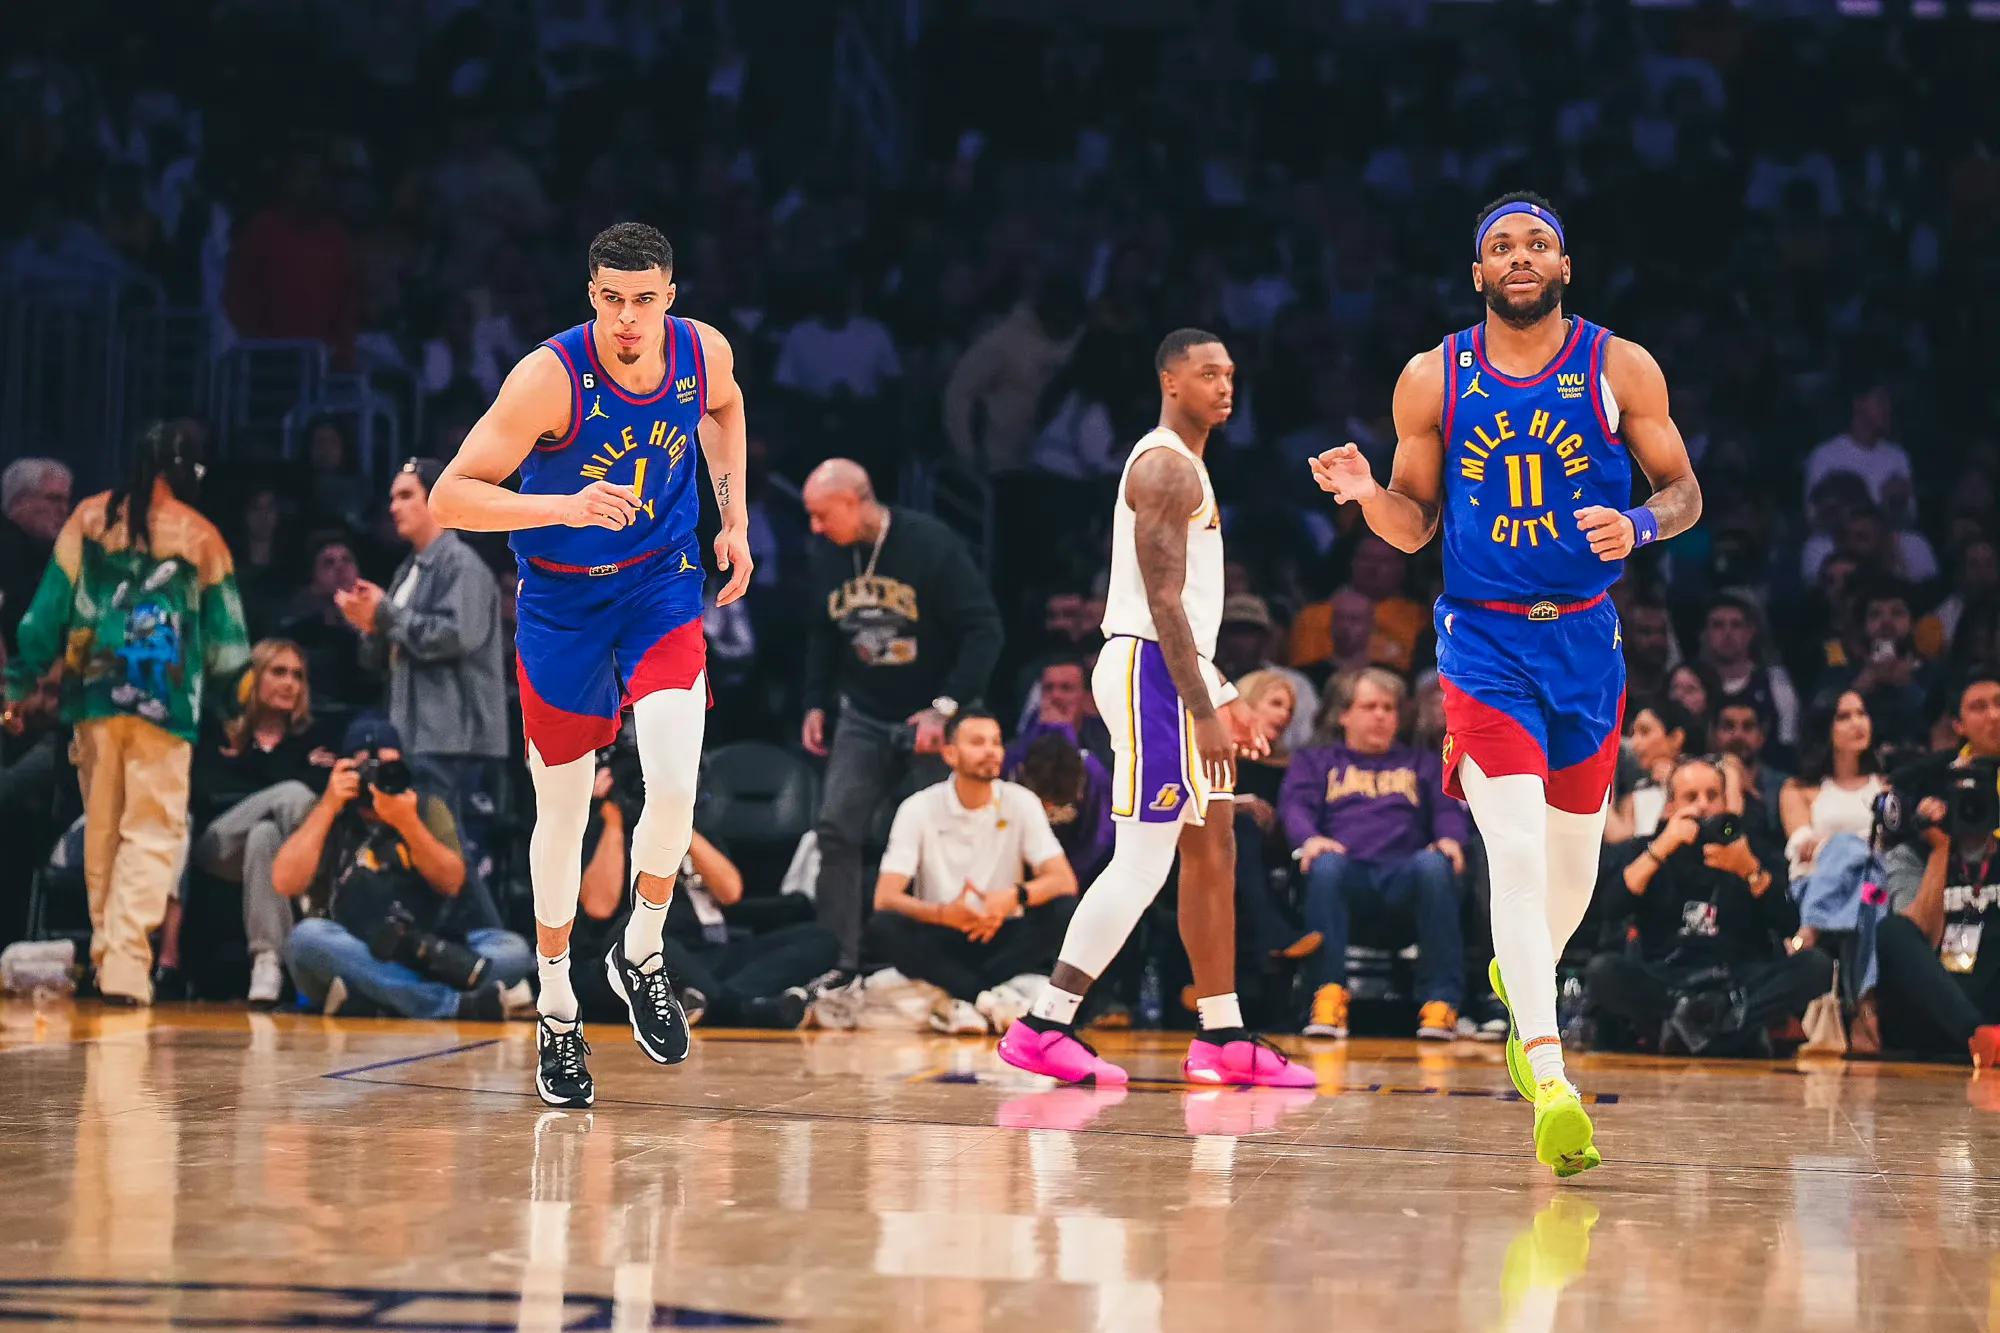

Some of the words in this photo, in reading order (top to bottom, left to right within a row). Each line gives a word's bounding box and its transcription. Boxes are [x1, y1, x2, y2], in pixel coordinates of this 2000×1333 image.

[1459, 351, 1473, 368] 6
[583, 373, 595, 389] 6
[675, 375, 697, 393] WU
[1556, 373, 1585, 386] WU
[676, 389, 697, 400] Western
[1556, 385, 1585, 394] Western
[1561, 392, 1583, 400] Union
[679, 396, 695, 404] Union
[579, 425, 639, 481] MILE
[1460, 410, 1516, 482] MILE
[1528, 408, 1589, 478] HIGH
[632, 457, 648, 500] 1
[1504, 453, 1544, 509] 11
[1491, 510, 1559, 548] CITY
